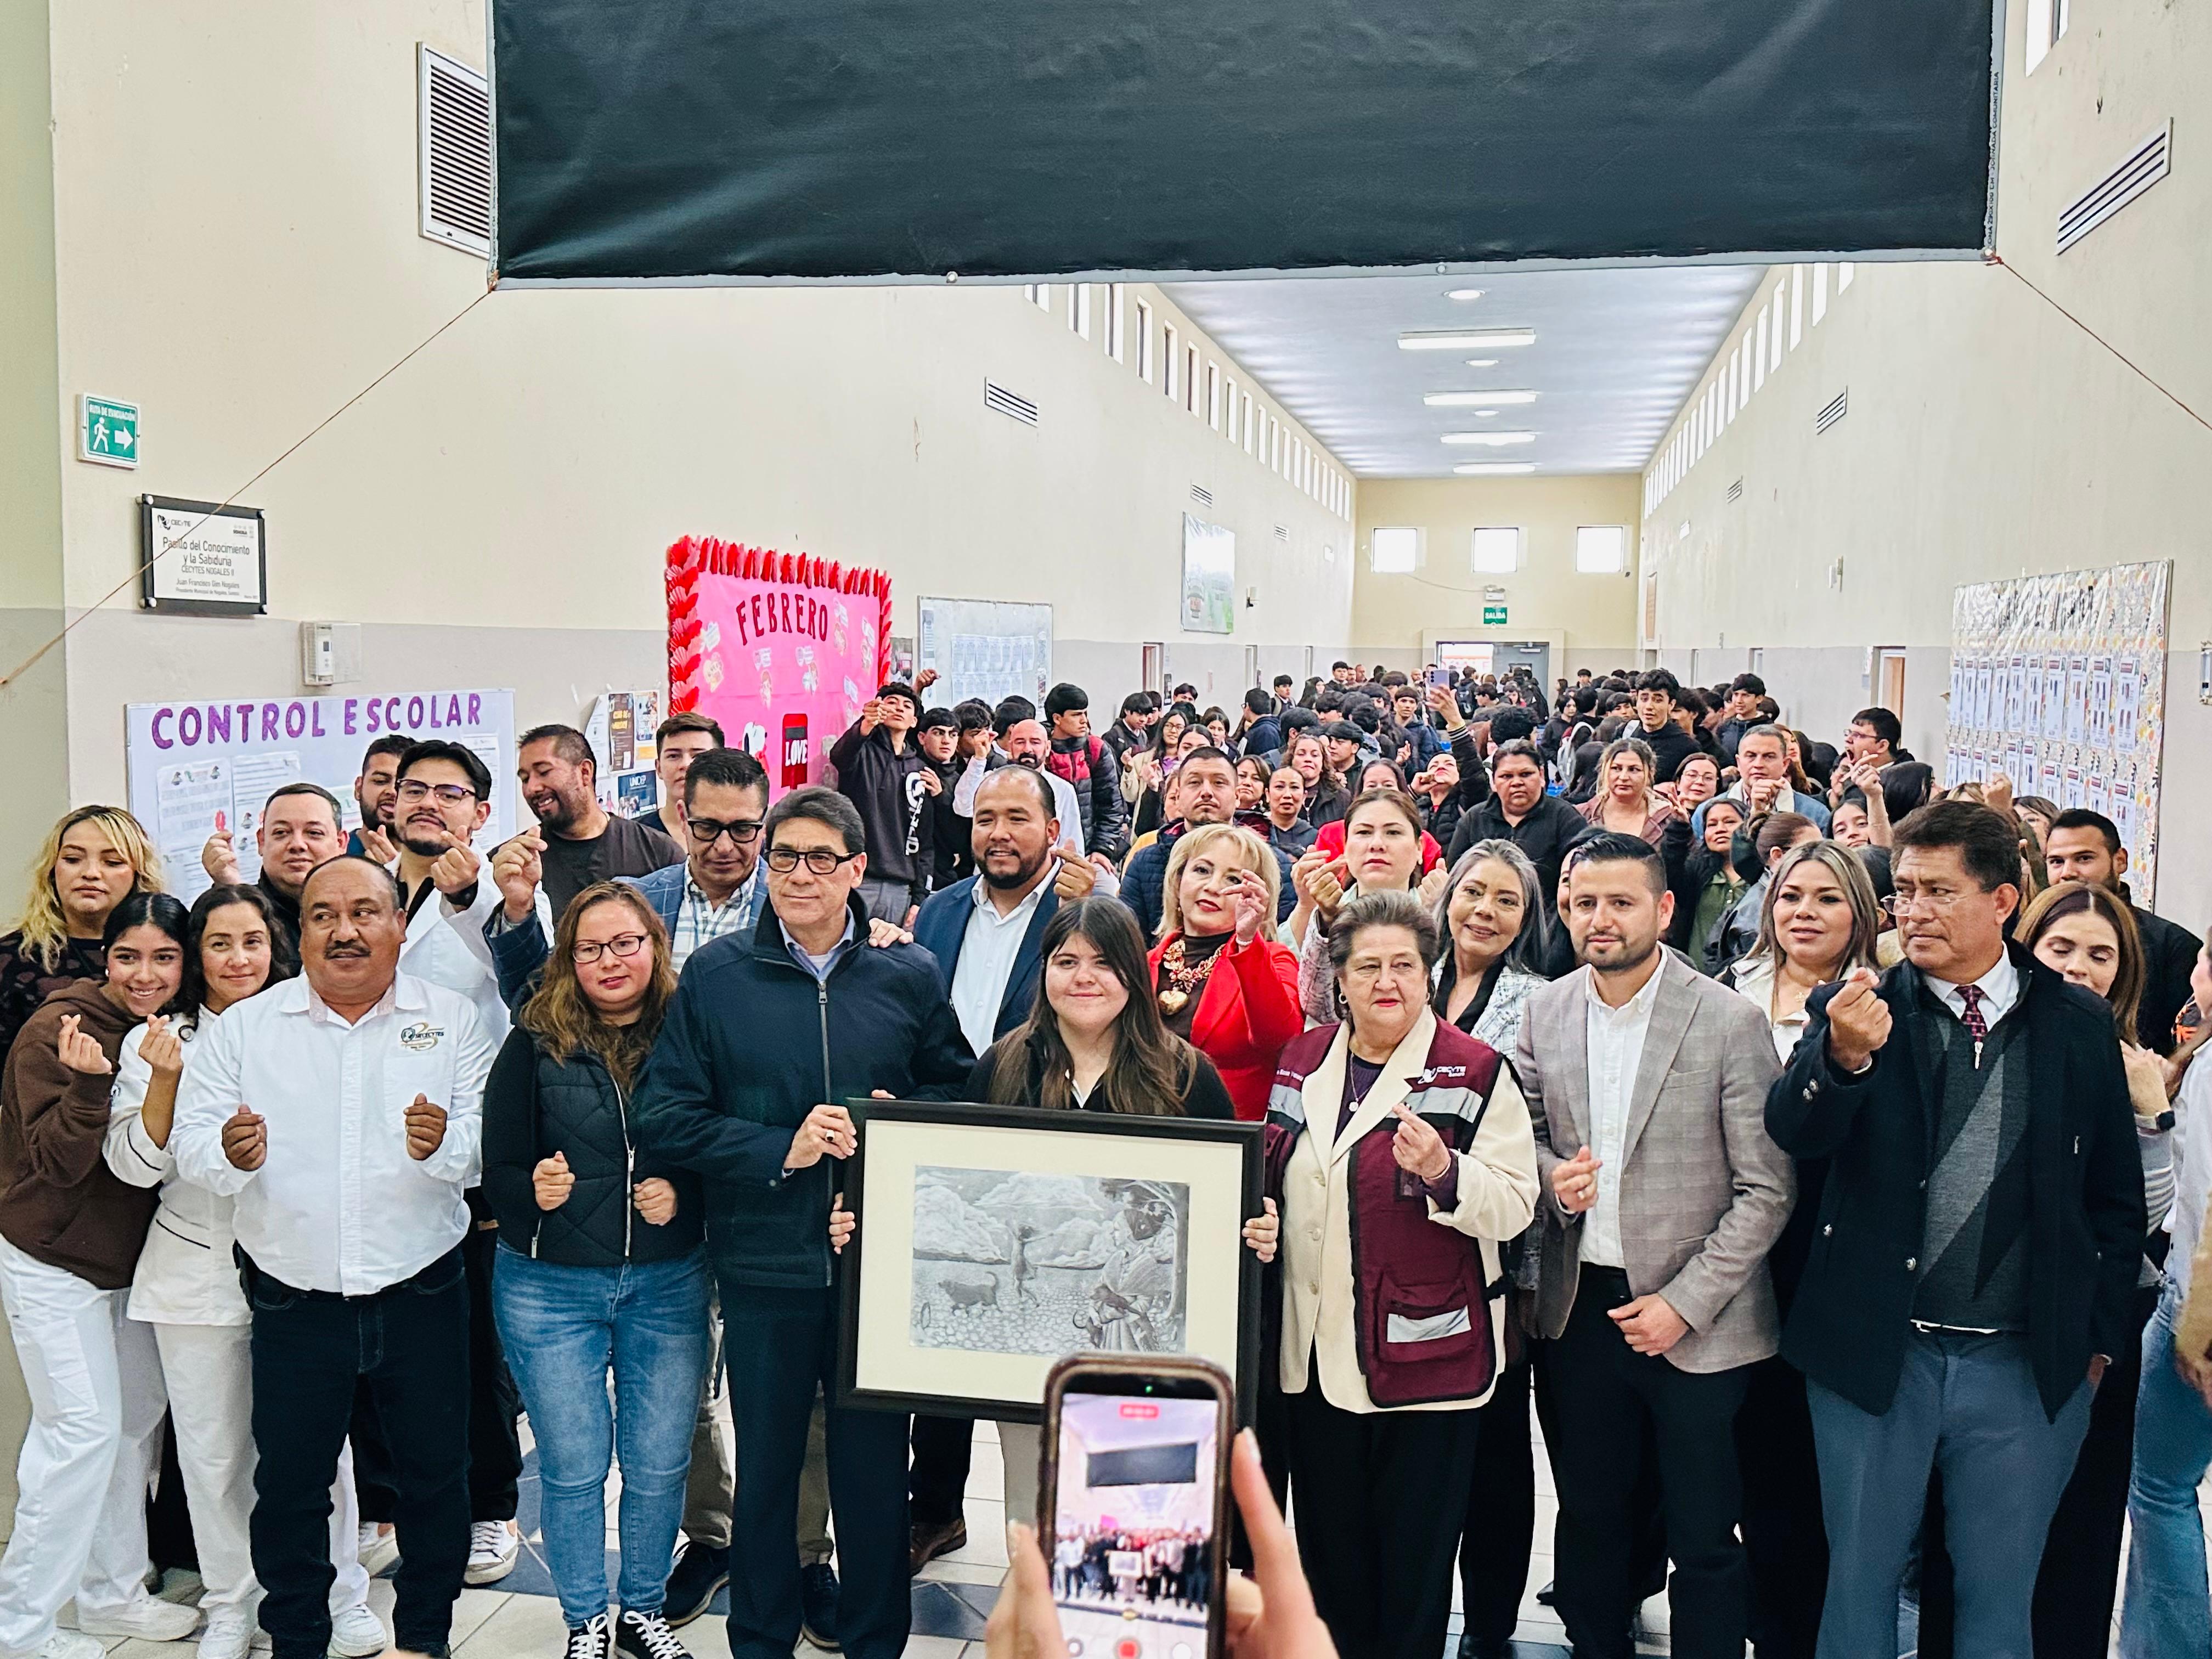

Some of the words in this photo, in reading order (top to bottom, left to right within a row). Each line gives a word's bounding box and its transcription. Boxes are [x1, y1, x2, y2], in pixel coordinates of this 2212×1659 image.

[190, 539, 201, 550] del
[203, 540, 250, 555] Conocimiento
[183, 555, 188, 565] y
[190, 552, 196, 563] la
[182, 565, 205, 574] CECYTES
[206, 567, 230, 575] NOGALES
[736, 592, 828, 646] FEBRERO
[152, 701, 325, 749] CONTROL
[345, 693, 481, 735] ESCOLAR
[785, 740, 808, 766] LOVE
